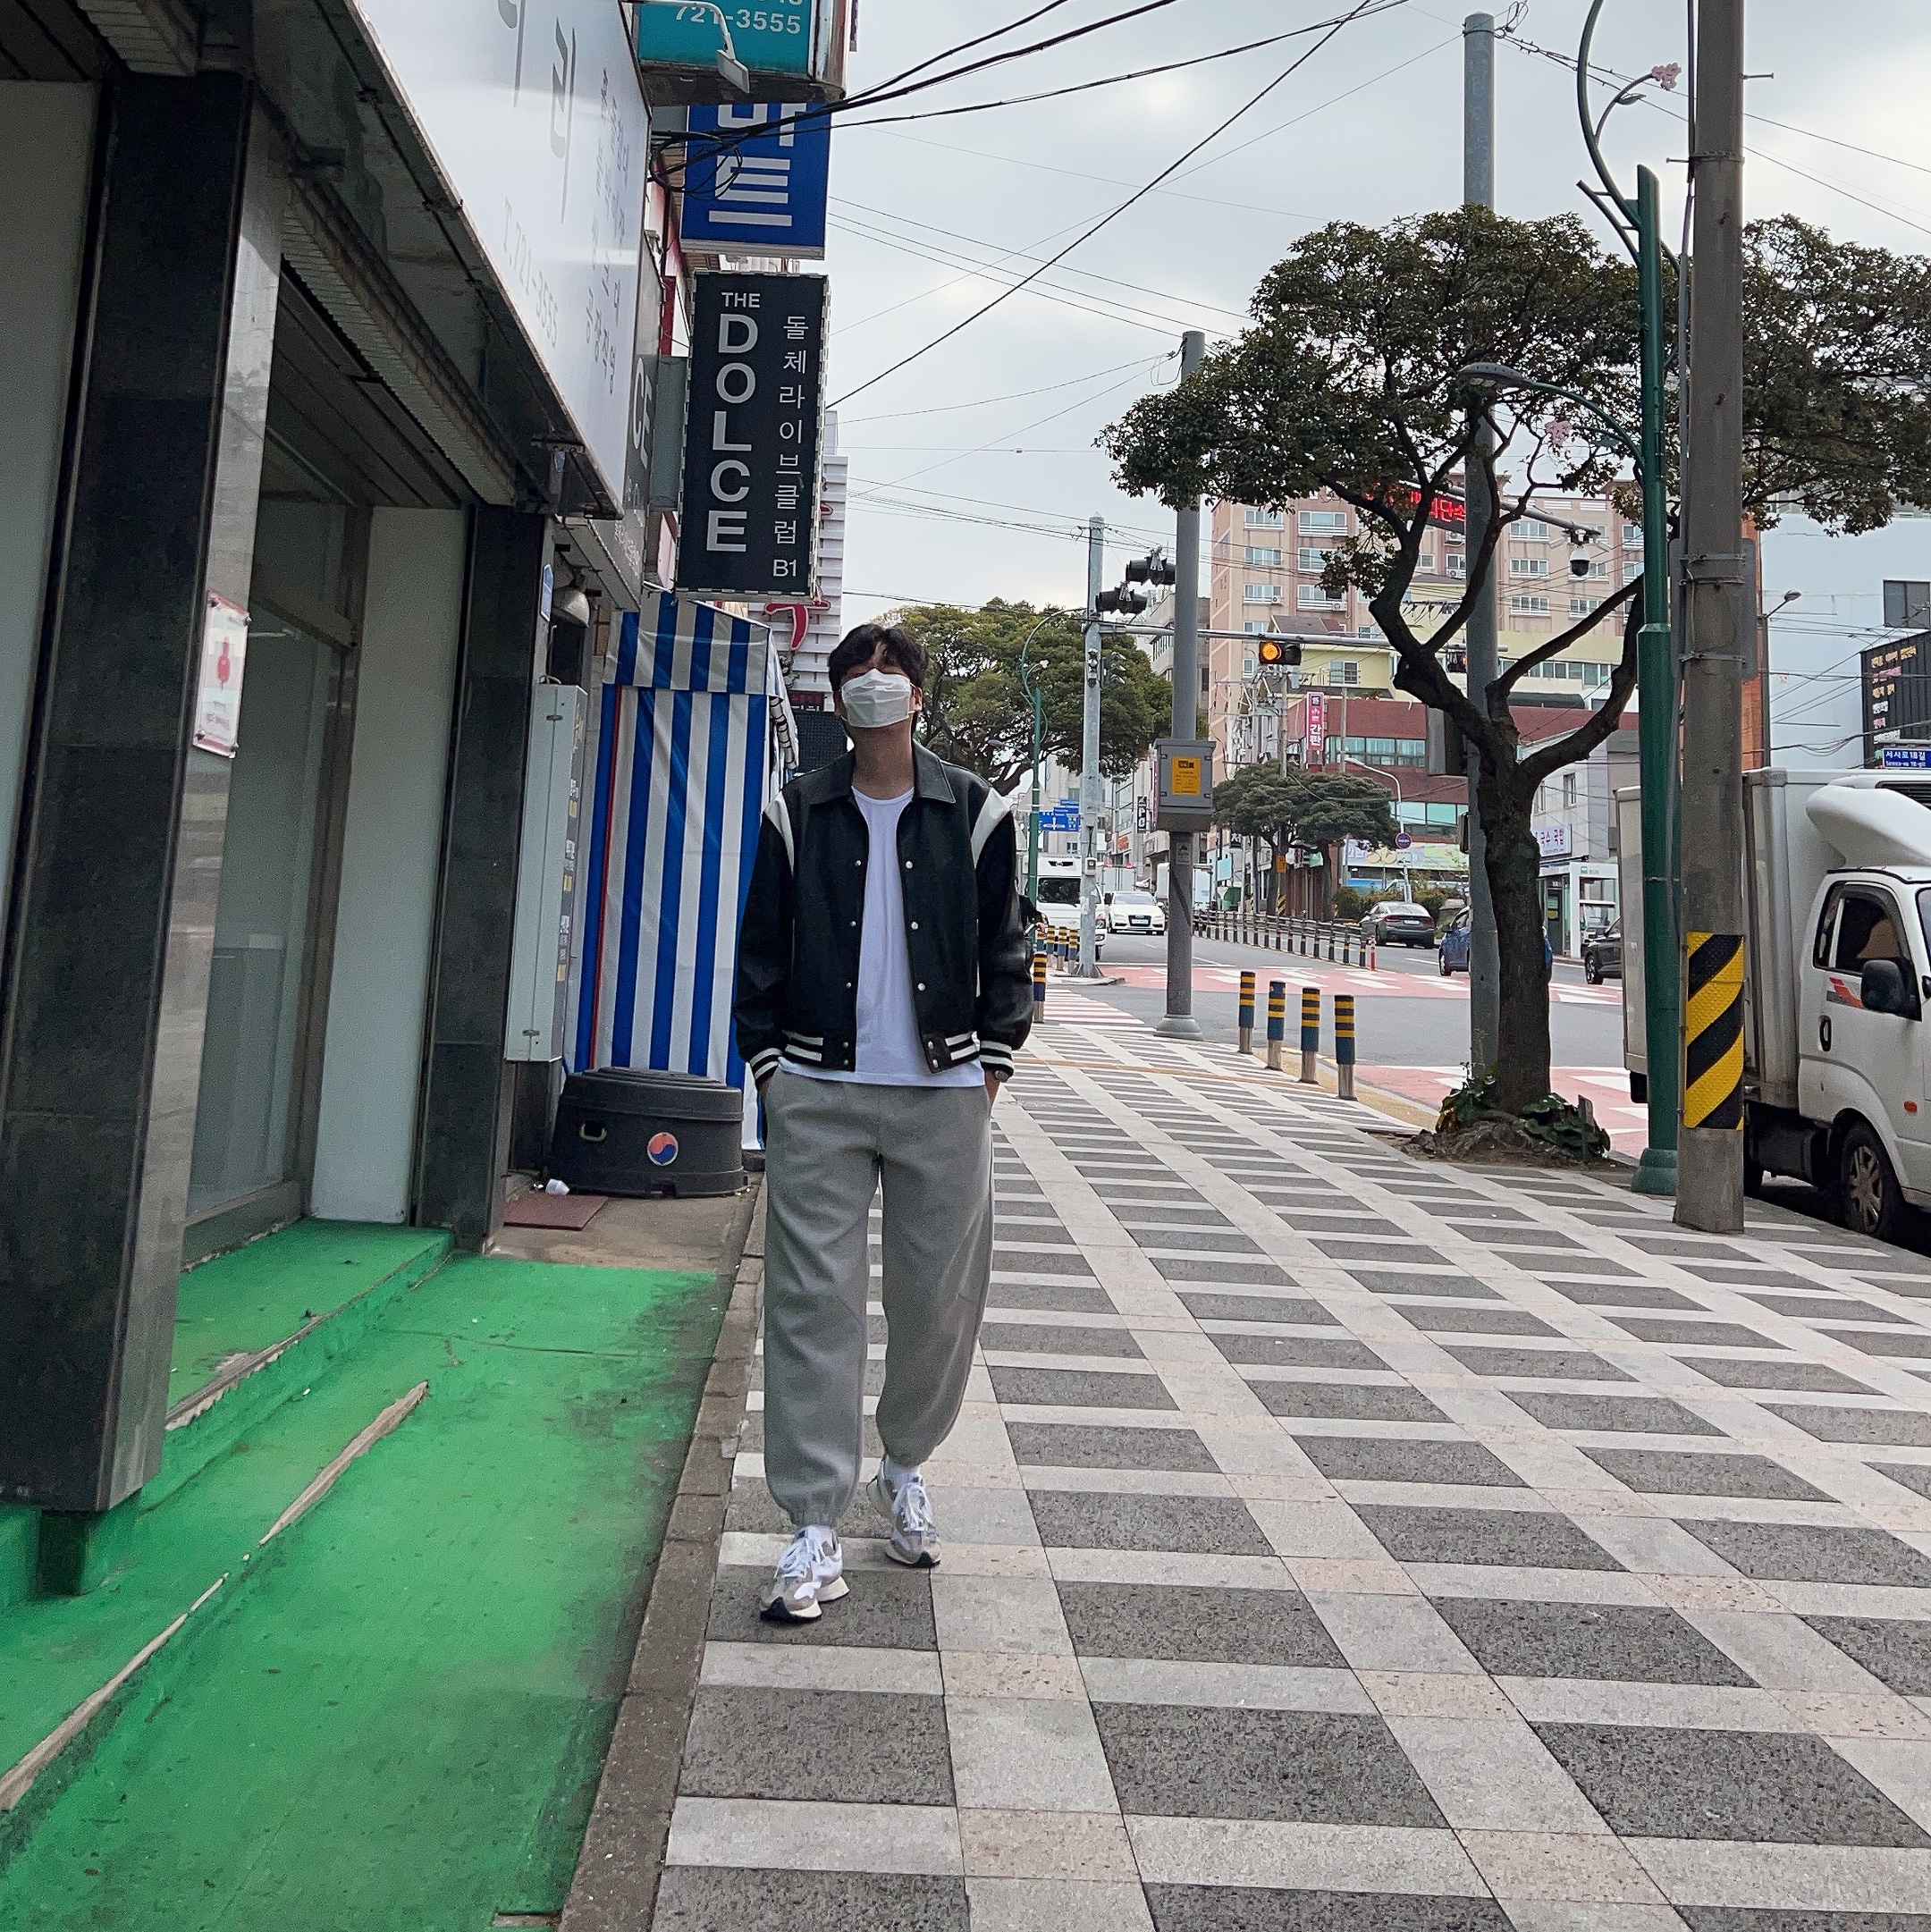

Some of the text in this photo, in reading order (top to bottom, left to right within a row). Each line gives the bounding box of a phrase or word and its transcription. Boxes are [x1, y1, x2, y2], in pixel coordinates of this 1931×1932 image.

[675, 6, 801, 35] 721-3555
[721, 291, 761, 309] THE
[586, 287, 616, 395] 공장직영
[705, 313, 759, 553] DOLCE
[773, 316, 809, 544] 돌체라이브클럽
[772, 559, 798, 578] B1
[1885, 750, 1926, 761] 서사로18길
